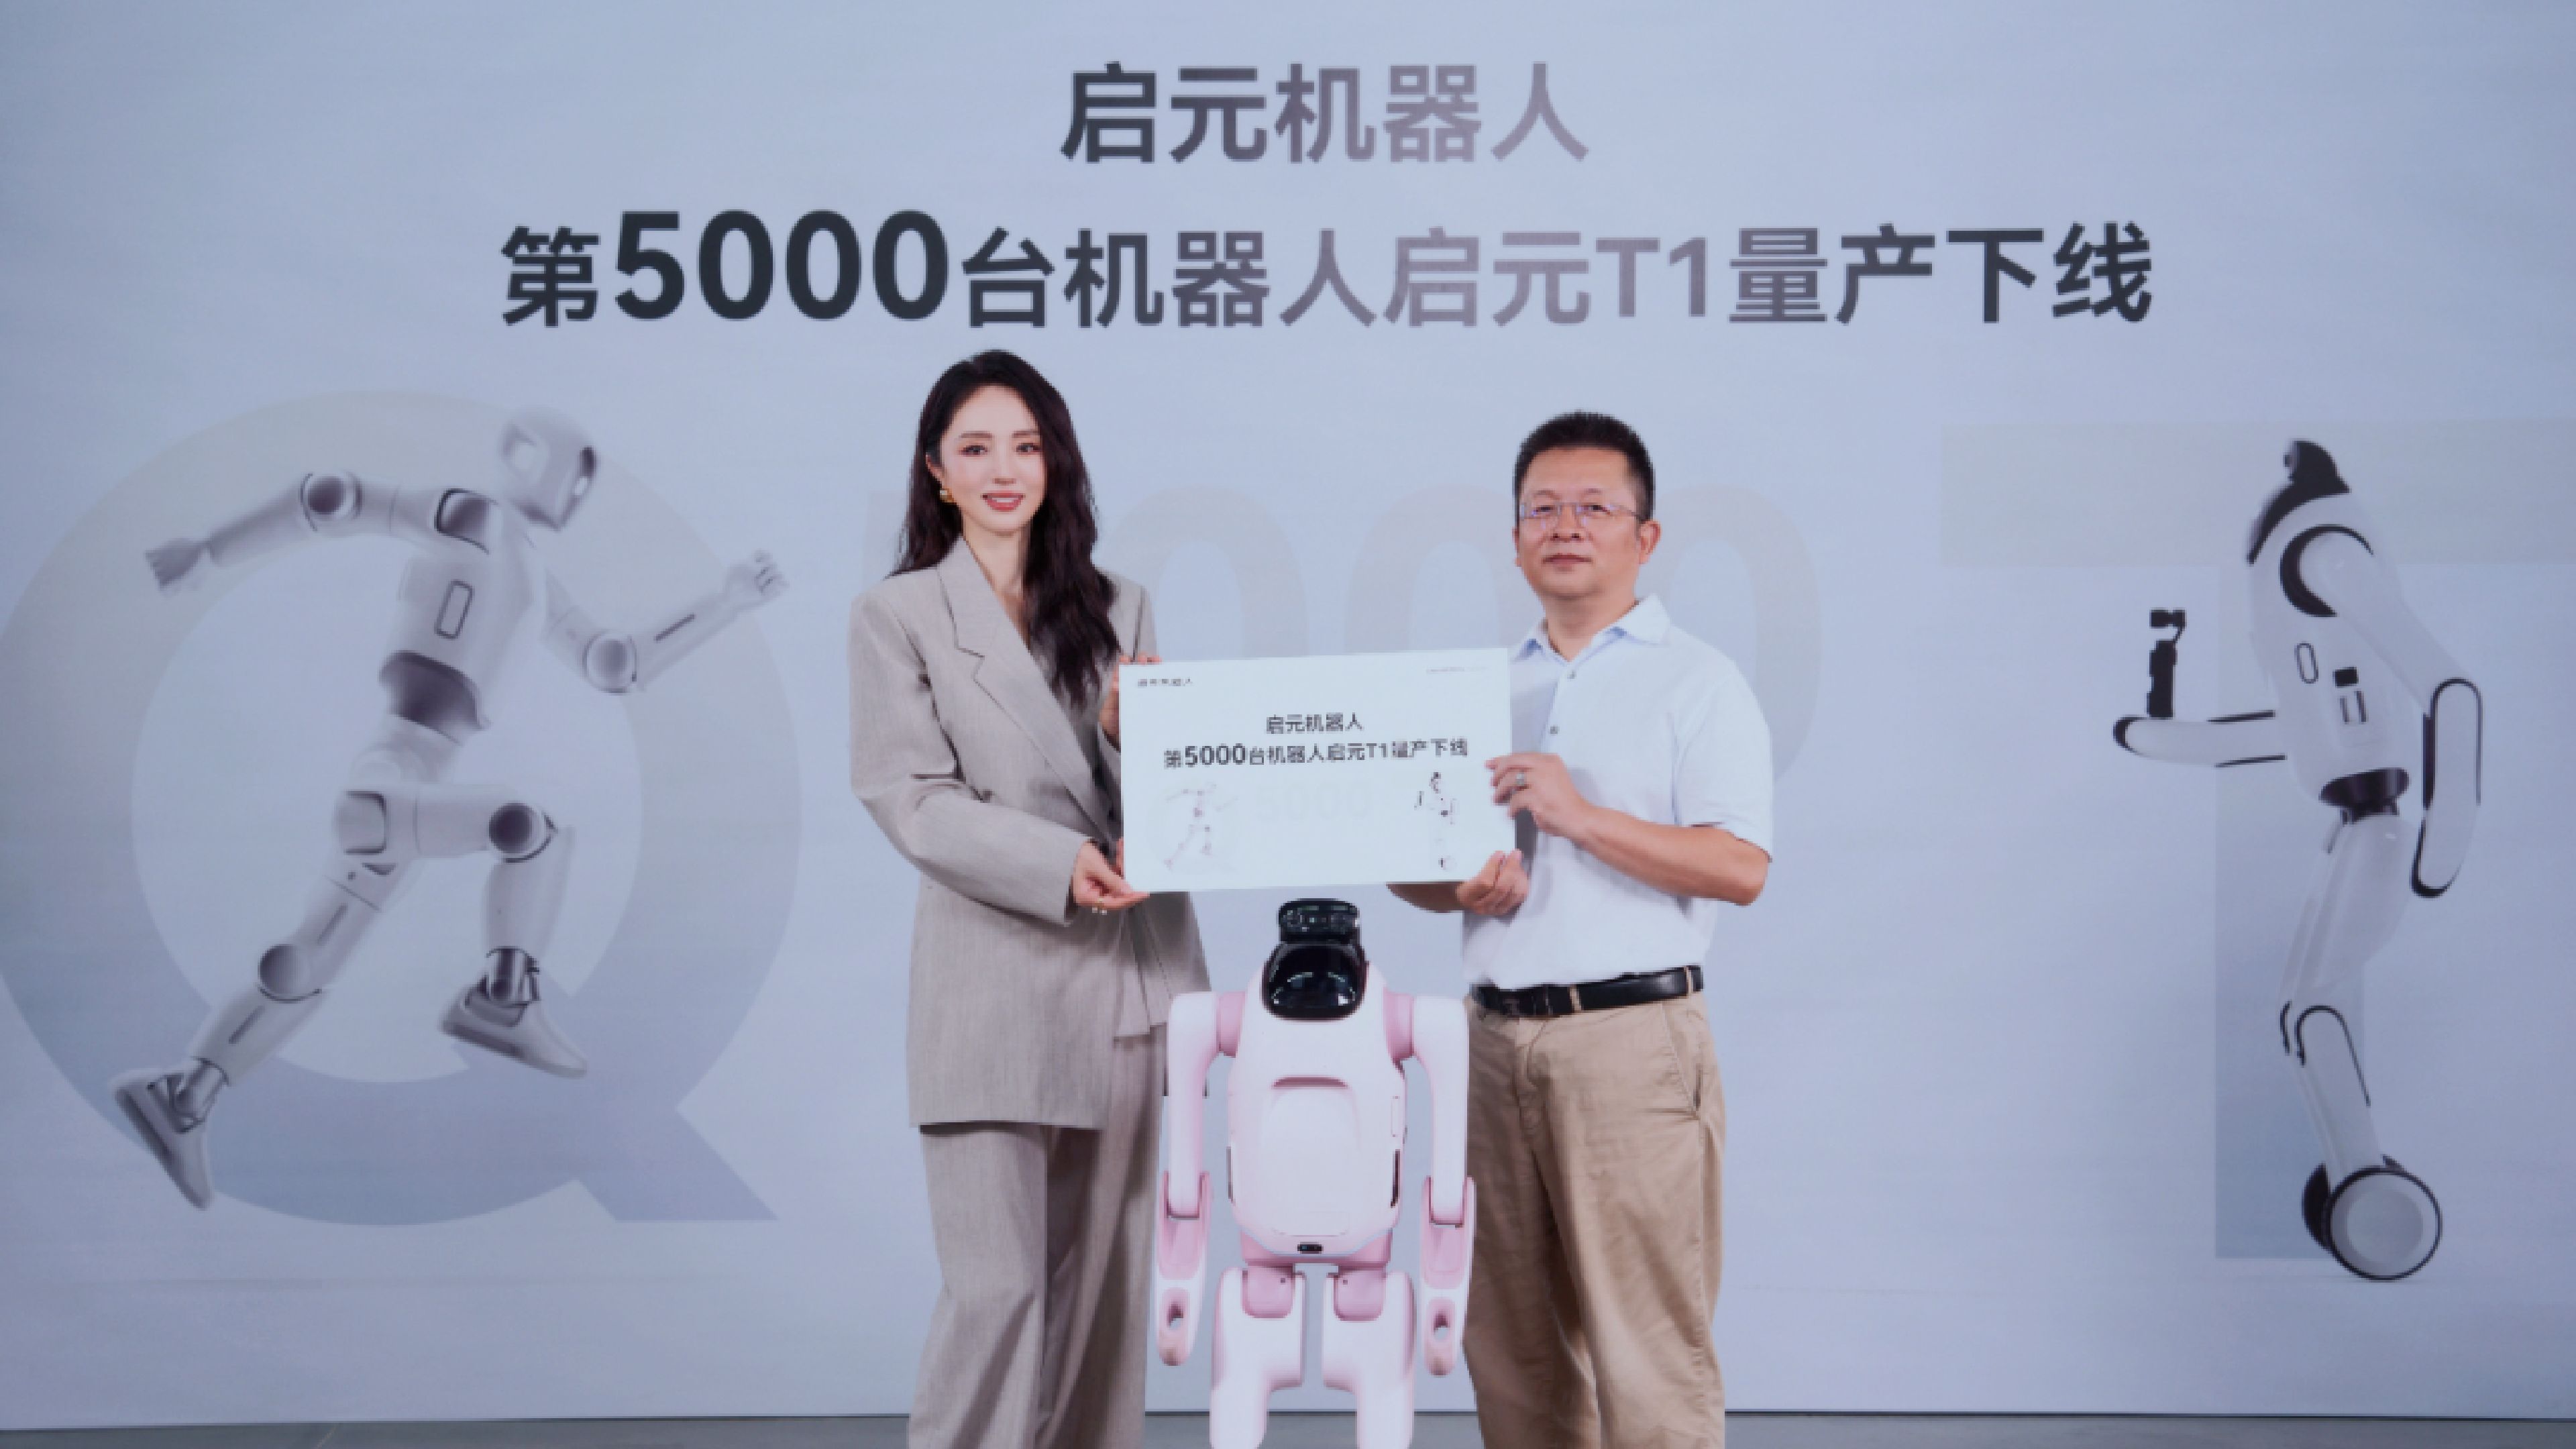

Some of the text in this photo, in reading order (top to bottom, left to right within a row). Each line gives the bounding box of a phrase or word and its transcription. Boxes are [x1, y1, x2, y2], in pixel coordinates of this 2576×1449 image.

[1059, 61, 1590, 164] 启元机器人
[499, 209, 2154, 328] 第5000台机器人启元T1量产下线
[1163, 738, 1469, 769] 第5000台机器人启元T1量产下线
[1266, 712, 1364, 735] 启元机器人
